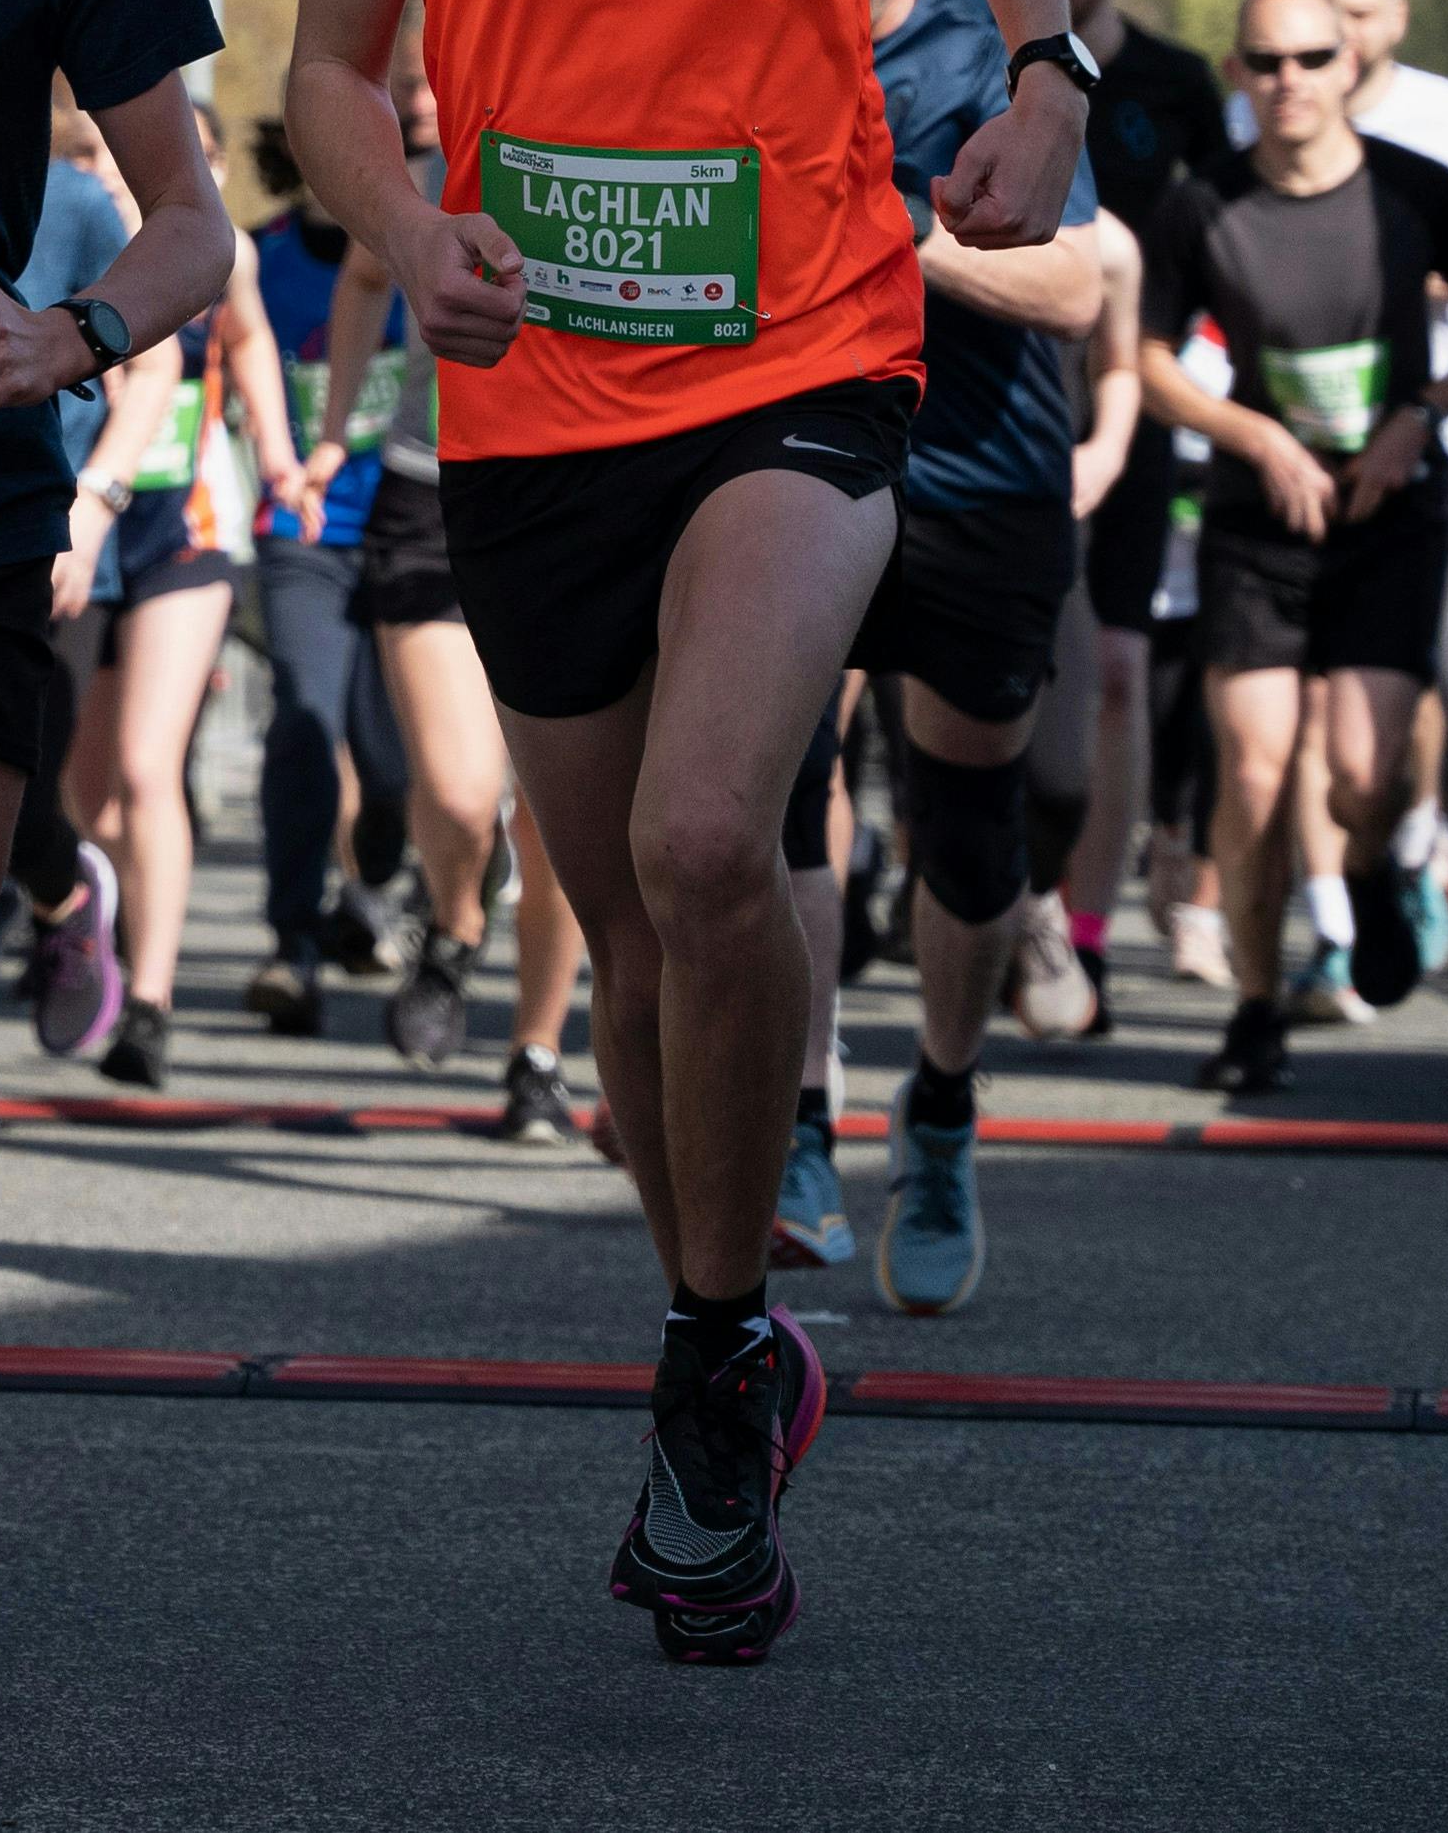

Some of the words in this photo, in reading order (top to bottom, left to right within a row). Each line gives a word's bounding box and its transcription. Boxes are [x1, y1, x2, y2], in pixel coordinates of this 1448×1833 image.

[690, 165, 724, 178] 5km
[522, 175, 710, 226] LACHLAN
[564, 226, 662, 269] 8021
[713, 323, 748, 337] 8021
